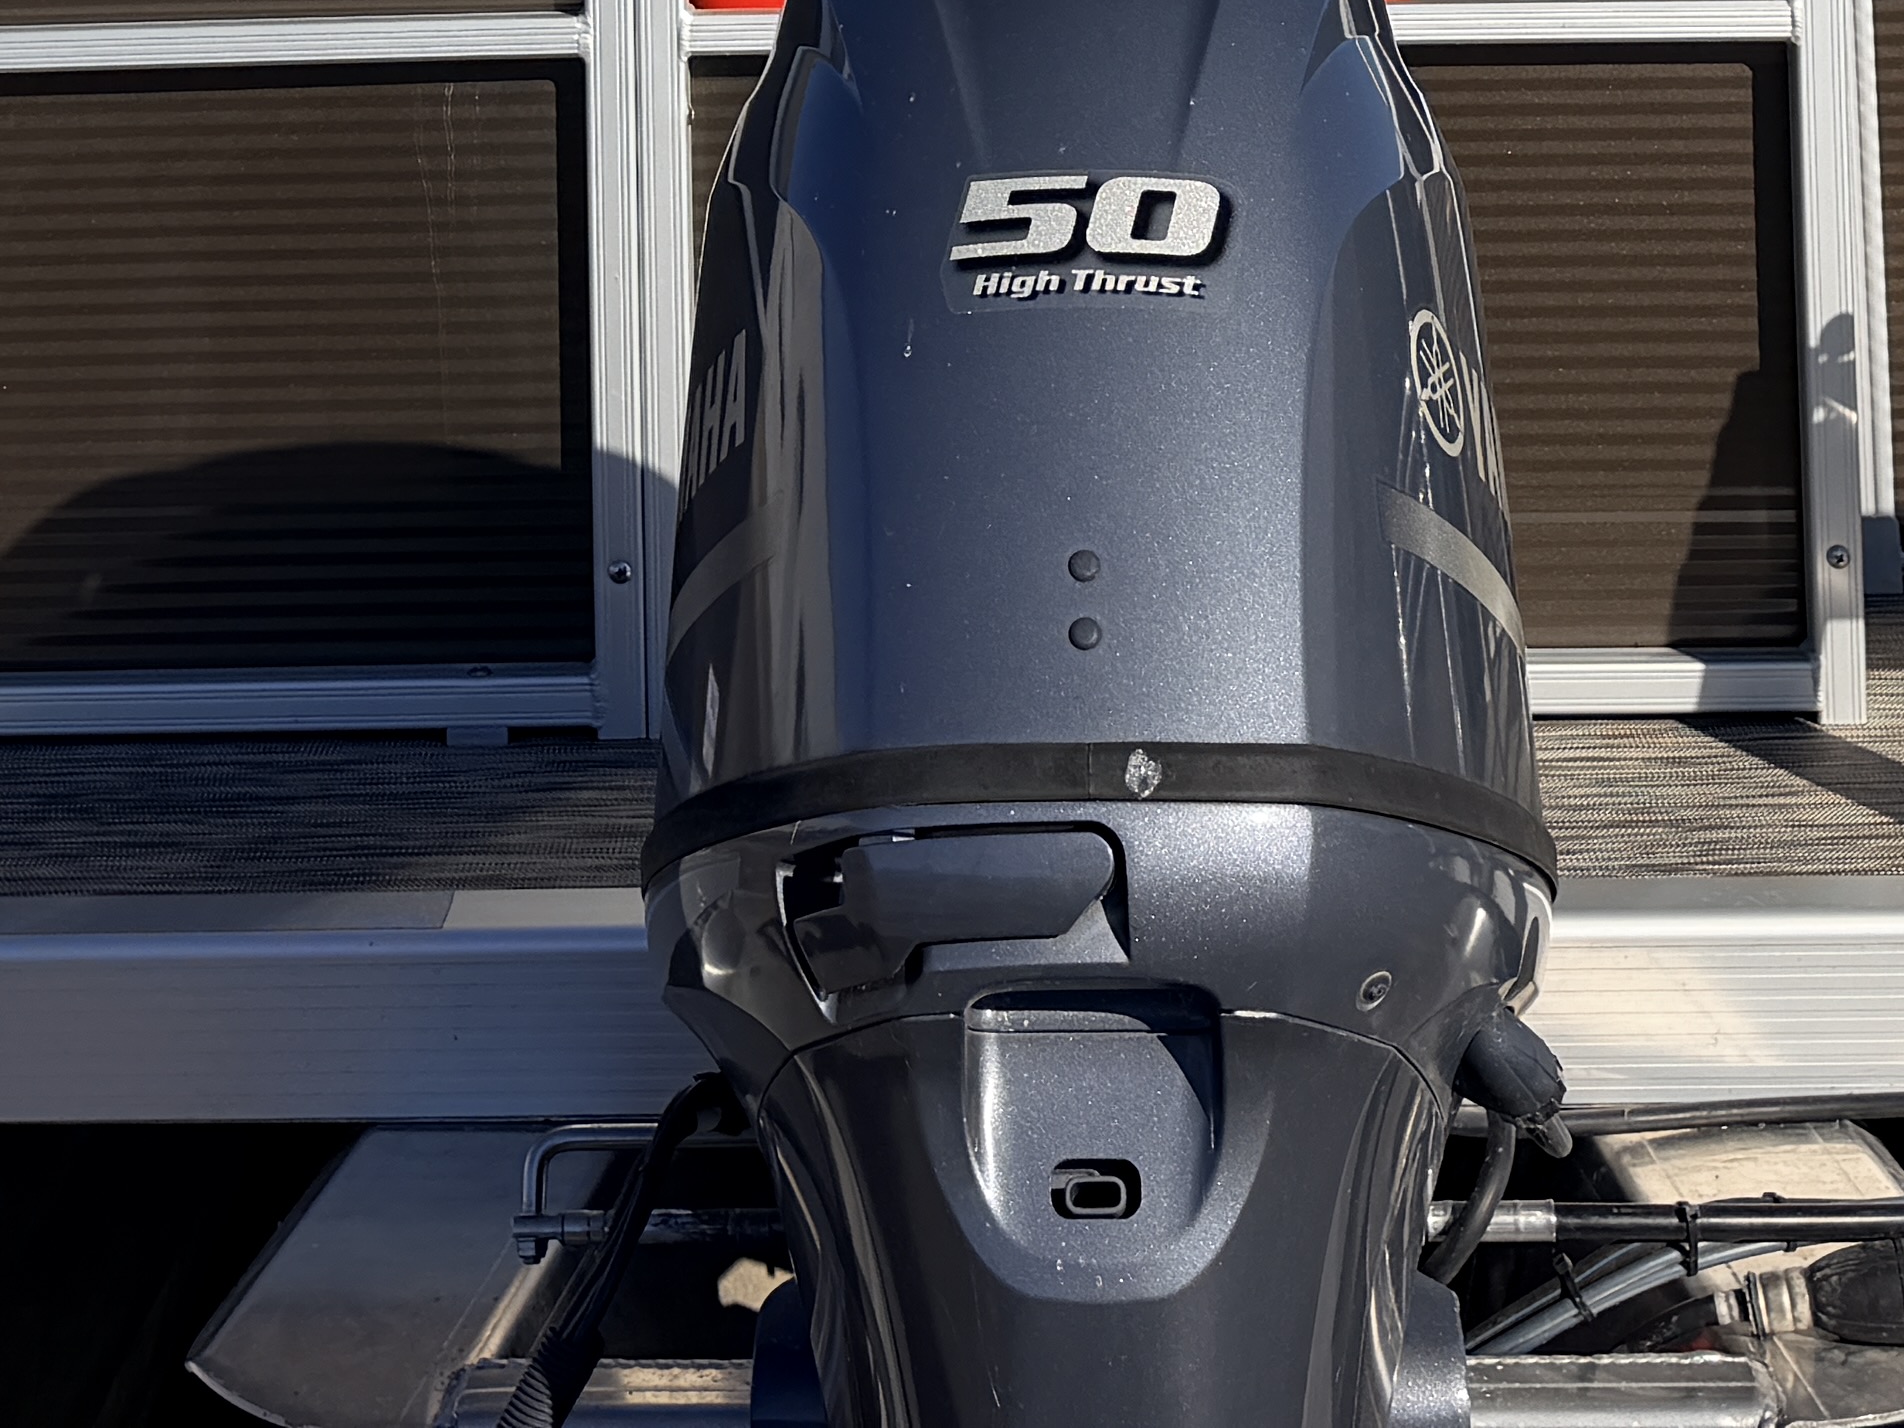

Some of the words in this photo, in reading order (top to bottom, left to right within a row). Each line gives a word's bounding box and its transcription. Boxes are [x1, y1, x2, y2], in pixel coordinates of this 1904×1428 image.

[949, 175, 1221, 261] 50
[972, 270, 1060, 298] High
[1071, 268, 1203, 296] Thrust
